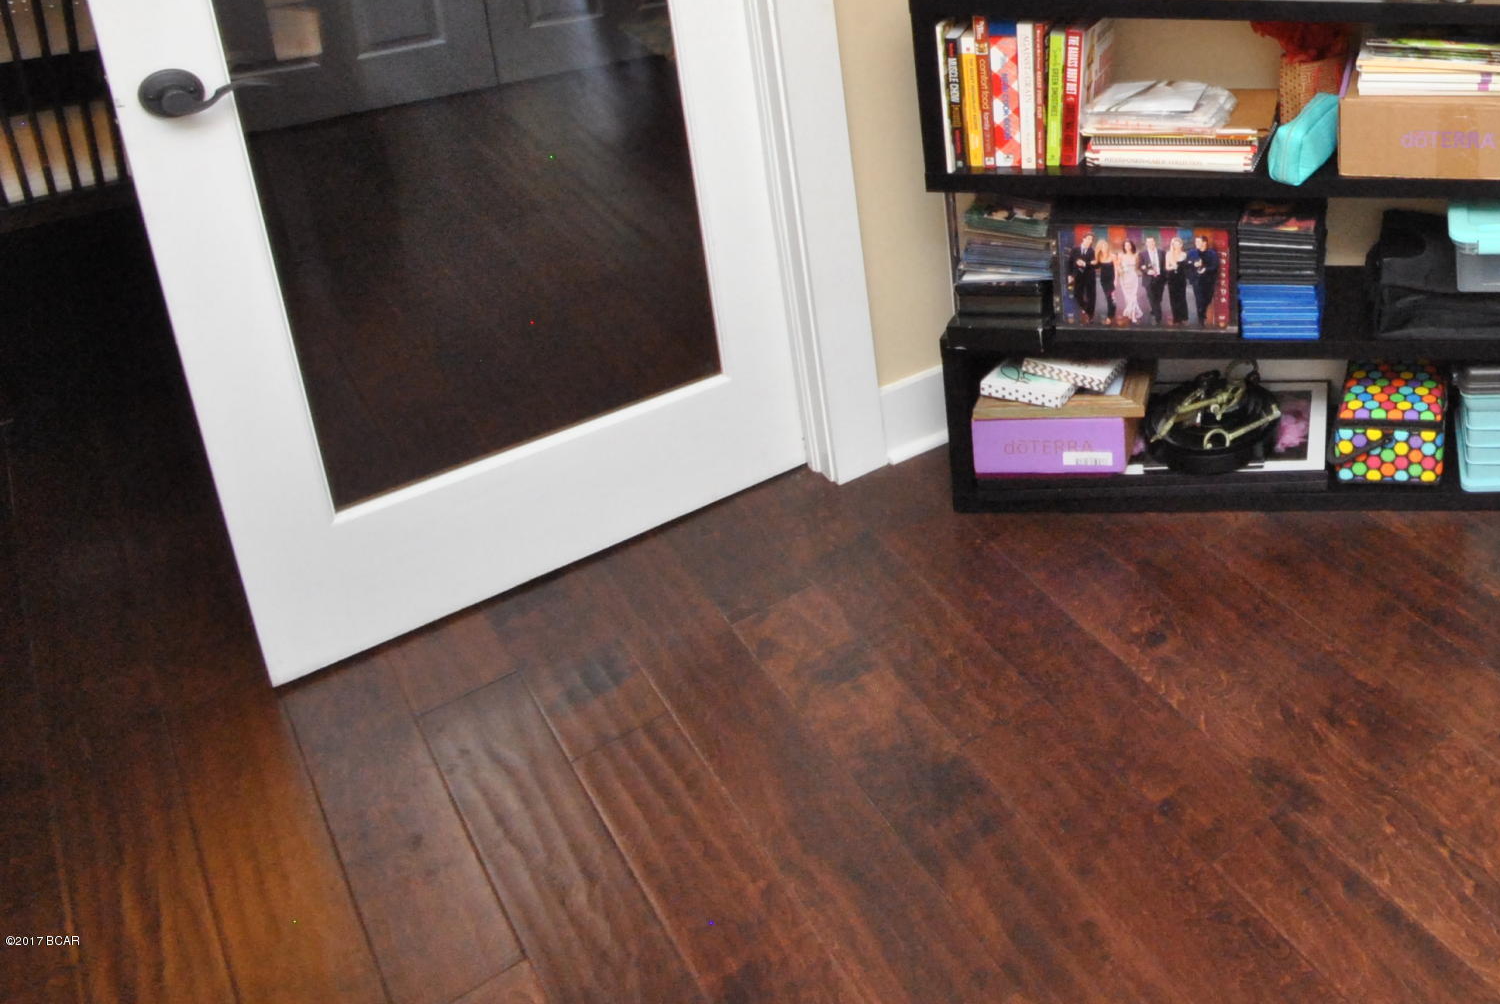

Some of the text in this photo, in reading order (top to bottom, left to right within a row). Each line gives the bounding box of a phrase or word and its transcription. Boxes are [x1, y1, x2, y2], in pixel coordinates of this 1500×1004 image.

[1068, 35, 1080, 46] THE
[949, 57, 960, 103] MUSCLE CHOW
[979, 58, 990, 110] comfort food
